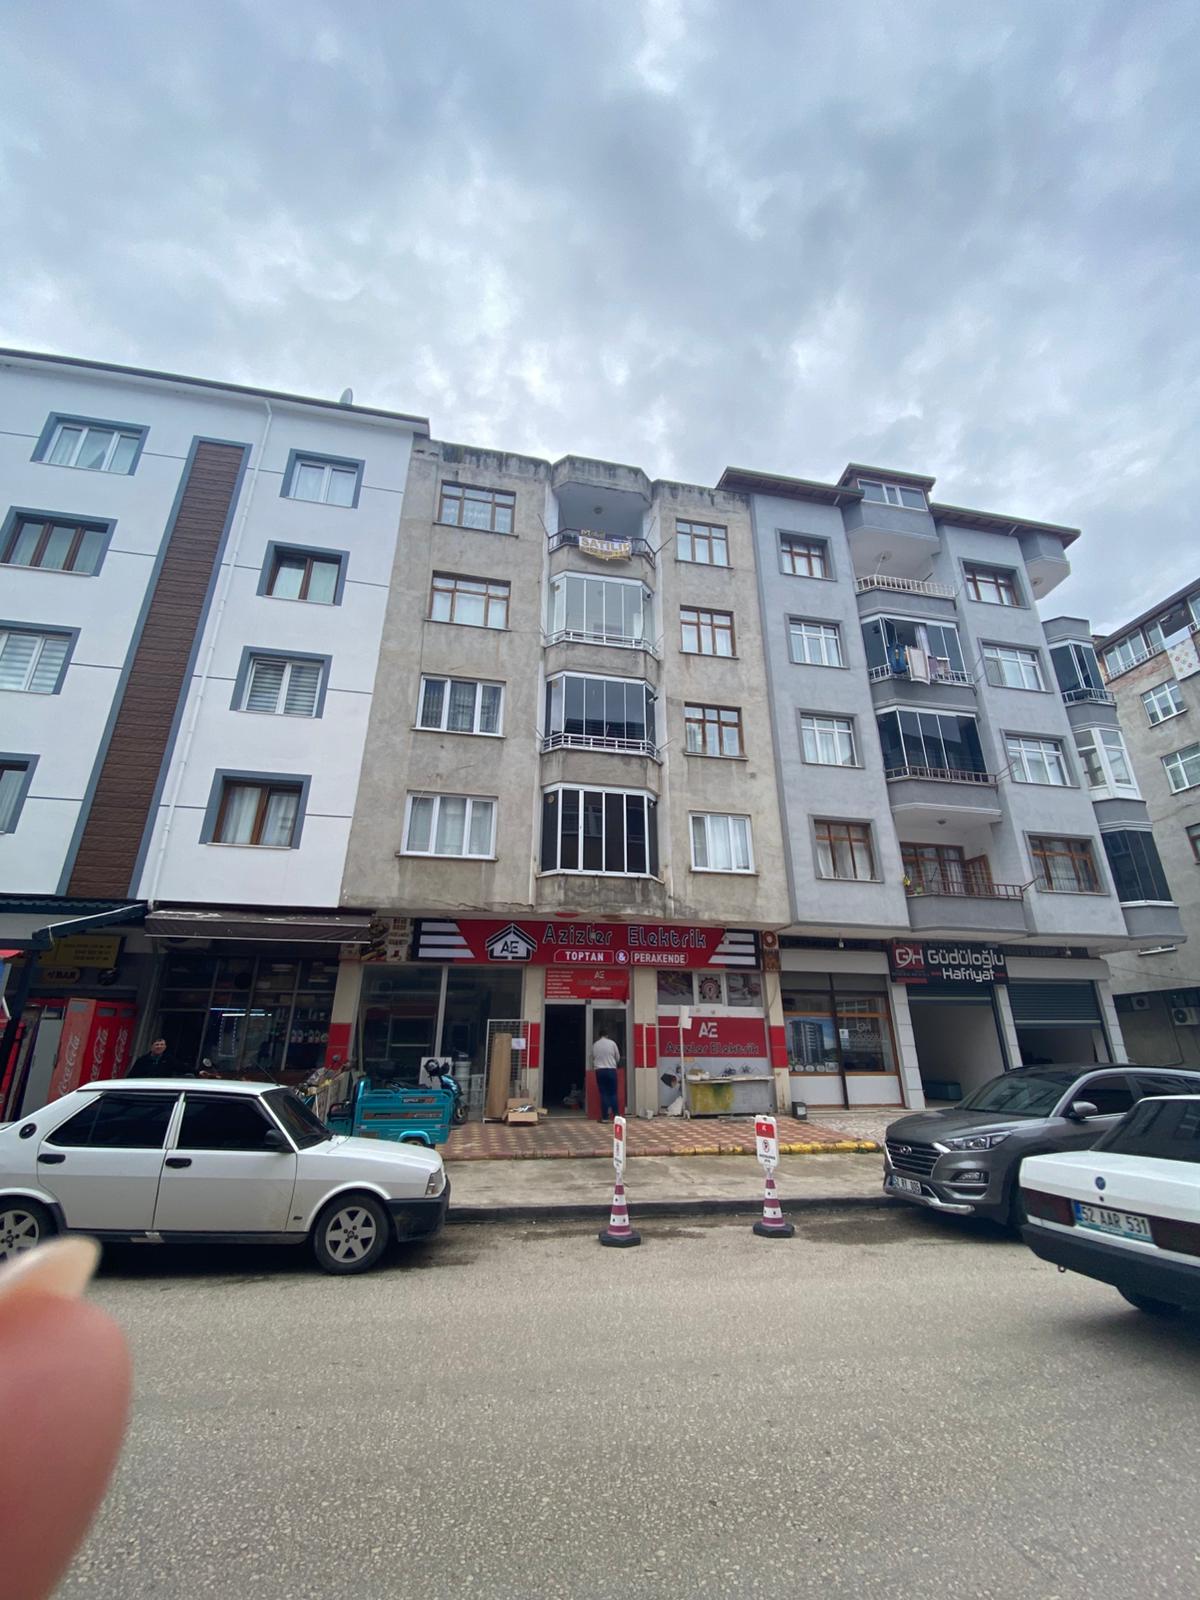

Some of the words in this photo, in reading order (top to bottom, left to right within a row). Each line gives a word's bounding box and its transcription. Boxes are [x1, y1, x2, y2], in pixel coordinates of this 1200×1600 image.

[542, 924, 613, 945] Azizler
[627, 926, 707, 948] Elektrik
[501, 940, 519, 954] AE
[565, 951, 604, 961] TOPTAN
[618, 952, 626, 961] &
[634, 953, 685, 964] PERAKENDE
[927, 948, 1004, 969] Güdüloğlu
[942, 967, 995, 983] Hafriyat
[698, 1022, 718, 1038] AE
[1081, 1206, 1096, 1223] 52
[1125, 1215, 1149, 1235] 531
